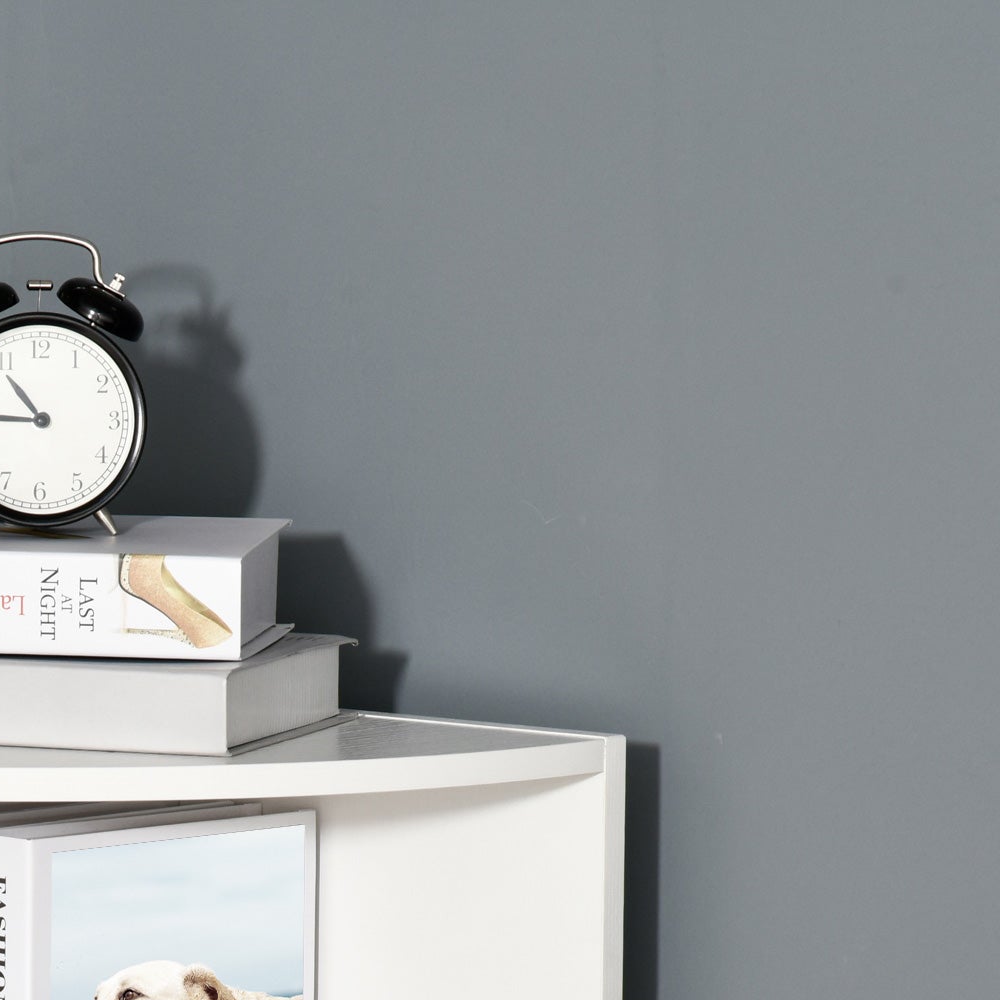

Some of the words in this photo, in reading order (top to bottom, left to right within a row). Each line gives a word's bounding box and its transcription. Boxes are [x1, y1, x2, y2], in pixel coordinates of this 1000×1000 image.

[30, 340, 50, 358] 12
[0, 352, 13, 370] 11
[72, 350, 78, 368] 1
[96, 374, 108, 394] 2
[108, 411, 120, 430] 3
[94, 446, 108, 464] 4
[0, 472, 12, 490] 7
[72, 472, 83, 492] 5
[33, 482, 46, 501] 6
[40, 567, 58, 641] NIGHT
[60, 594, 72, 614] AT
[78, 576, 96, 632] LAST
